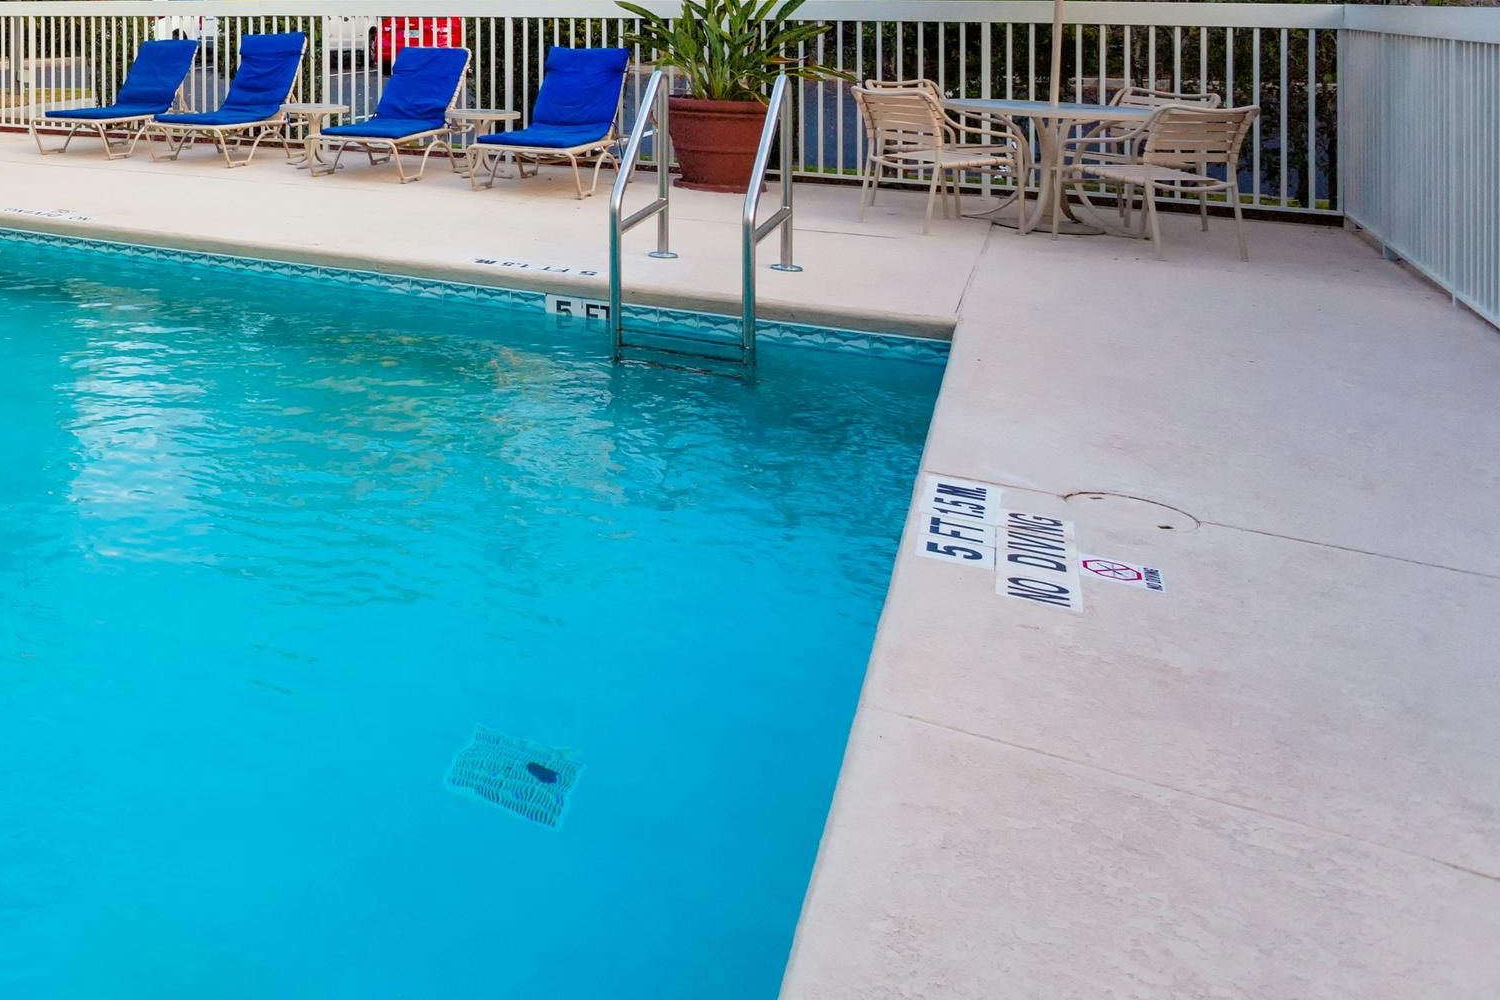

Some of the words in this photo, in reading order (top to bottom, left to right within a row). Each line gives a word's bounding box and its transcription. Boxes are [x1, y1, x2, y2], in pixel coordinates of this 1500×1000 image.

[936, 483, 987, 501] M.
[933, 496, 986, 519] 1.5
[929, 516, 984, 544] FT
[1007, 512, 1067, 573] DIVING
[926, 541, 983, 560] 5
[1007, 577, 1071, 608] NO
